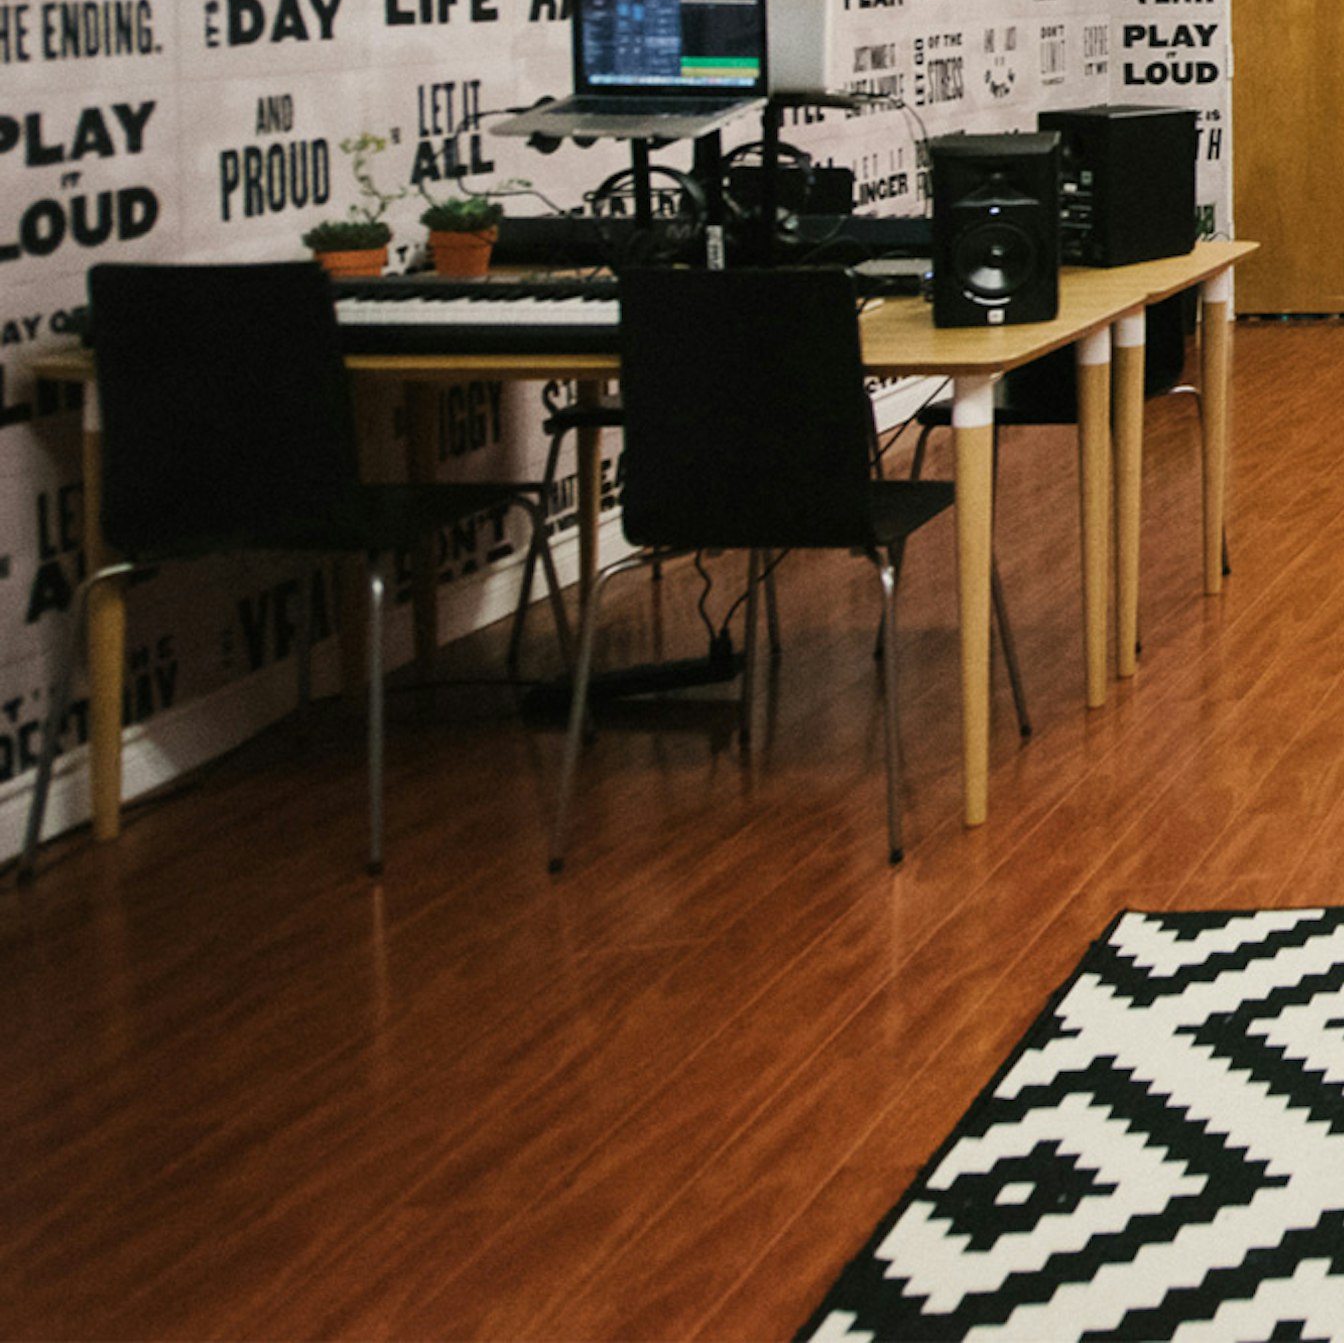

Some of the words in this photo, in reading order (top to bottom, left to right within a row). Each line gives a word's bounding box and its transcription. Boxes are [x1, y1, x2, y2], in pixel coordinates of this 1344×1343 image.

[1122, 23, 1218, 49] PLAY
[1123, 61, 1219, 86] LOUD
[412, 135, 495, 184] ALL
[219, 137, 331, 223] PROUD
